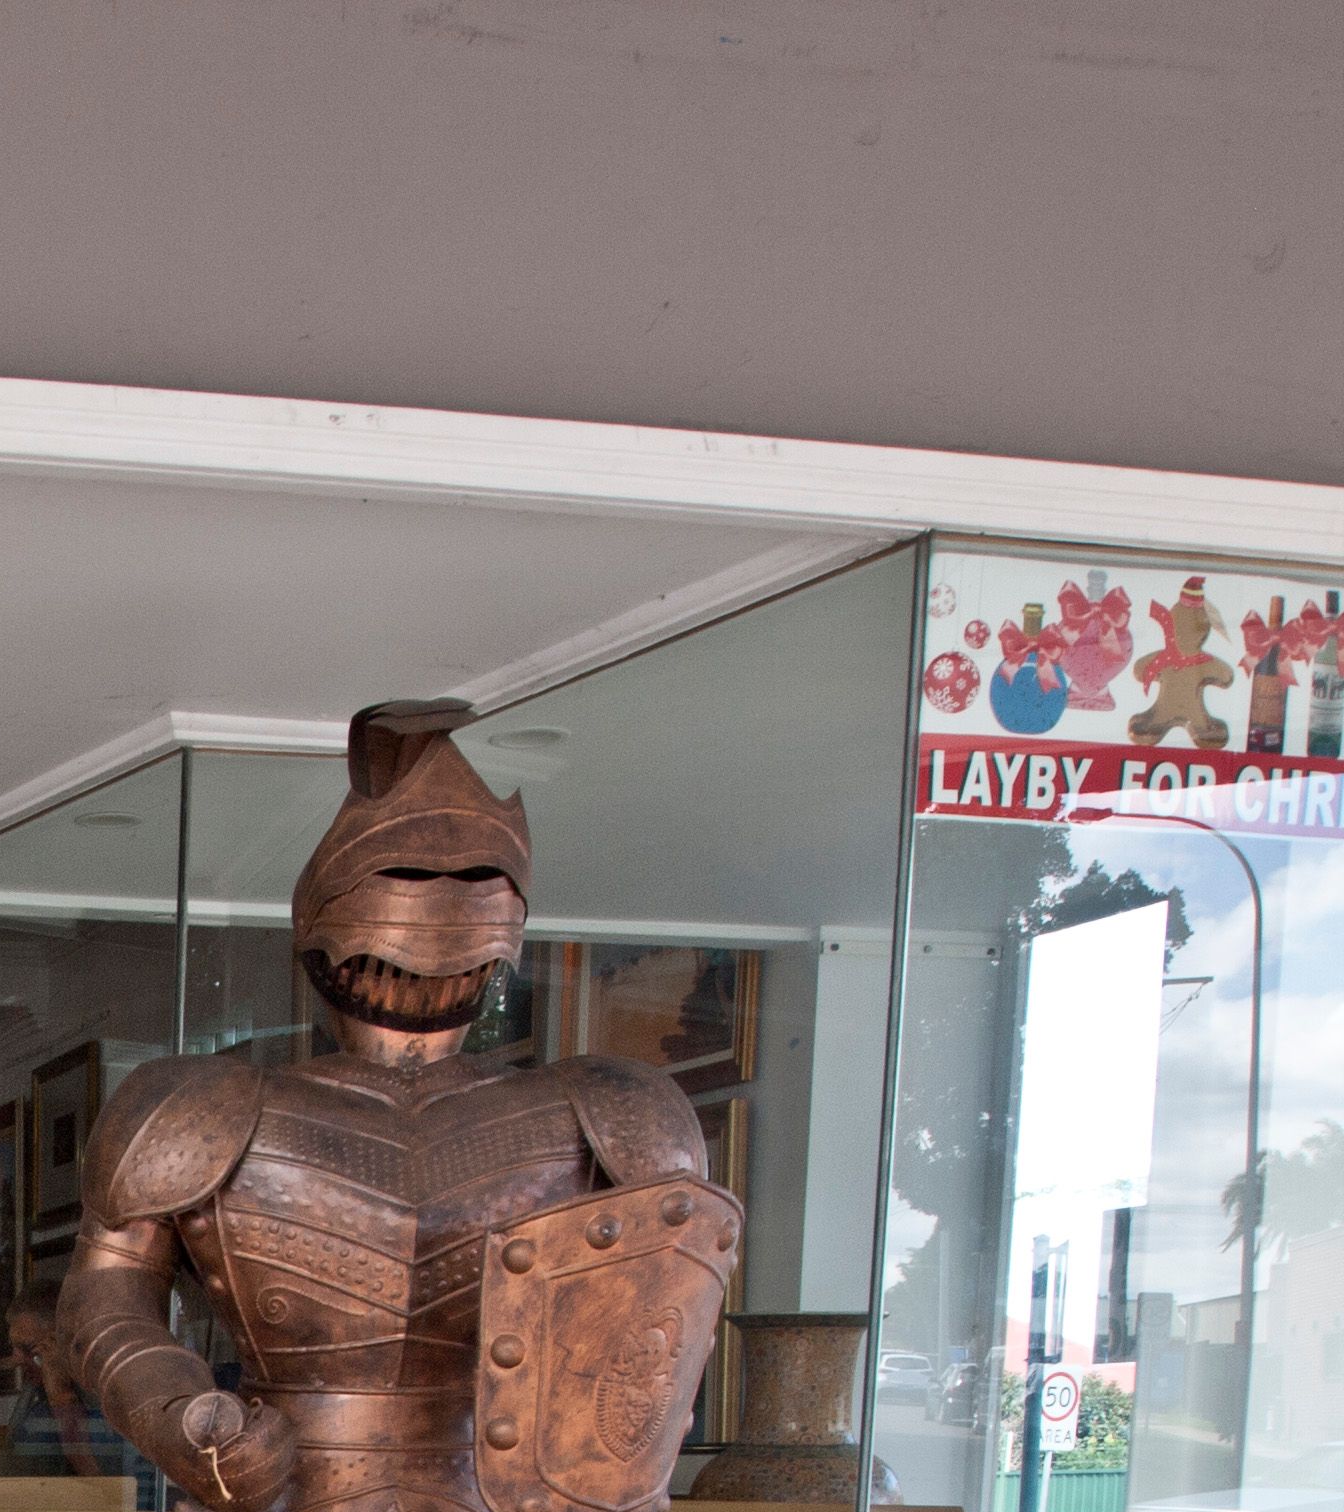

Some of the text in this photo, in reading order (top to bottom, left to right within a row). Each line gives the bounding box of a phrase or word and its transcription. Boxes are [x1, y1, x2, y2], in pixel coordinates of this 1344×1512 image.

[930, 748, 1094, 812] LAYBY
[1119, 759, 1218, 818] FOR
[1045, 1386, 1071, 1408] 50
